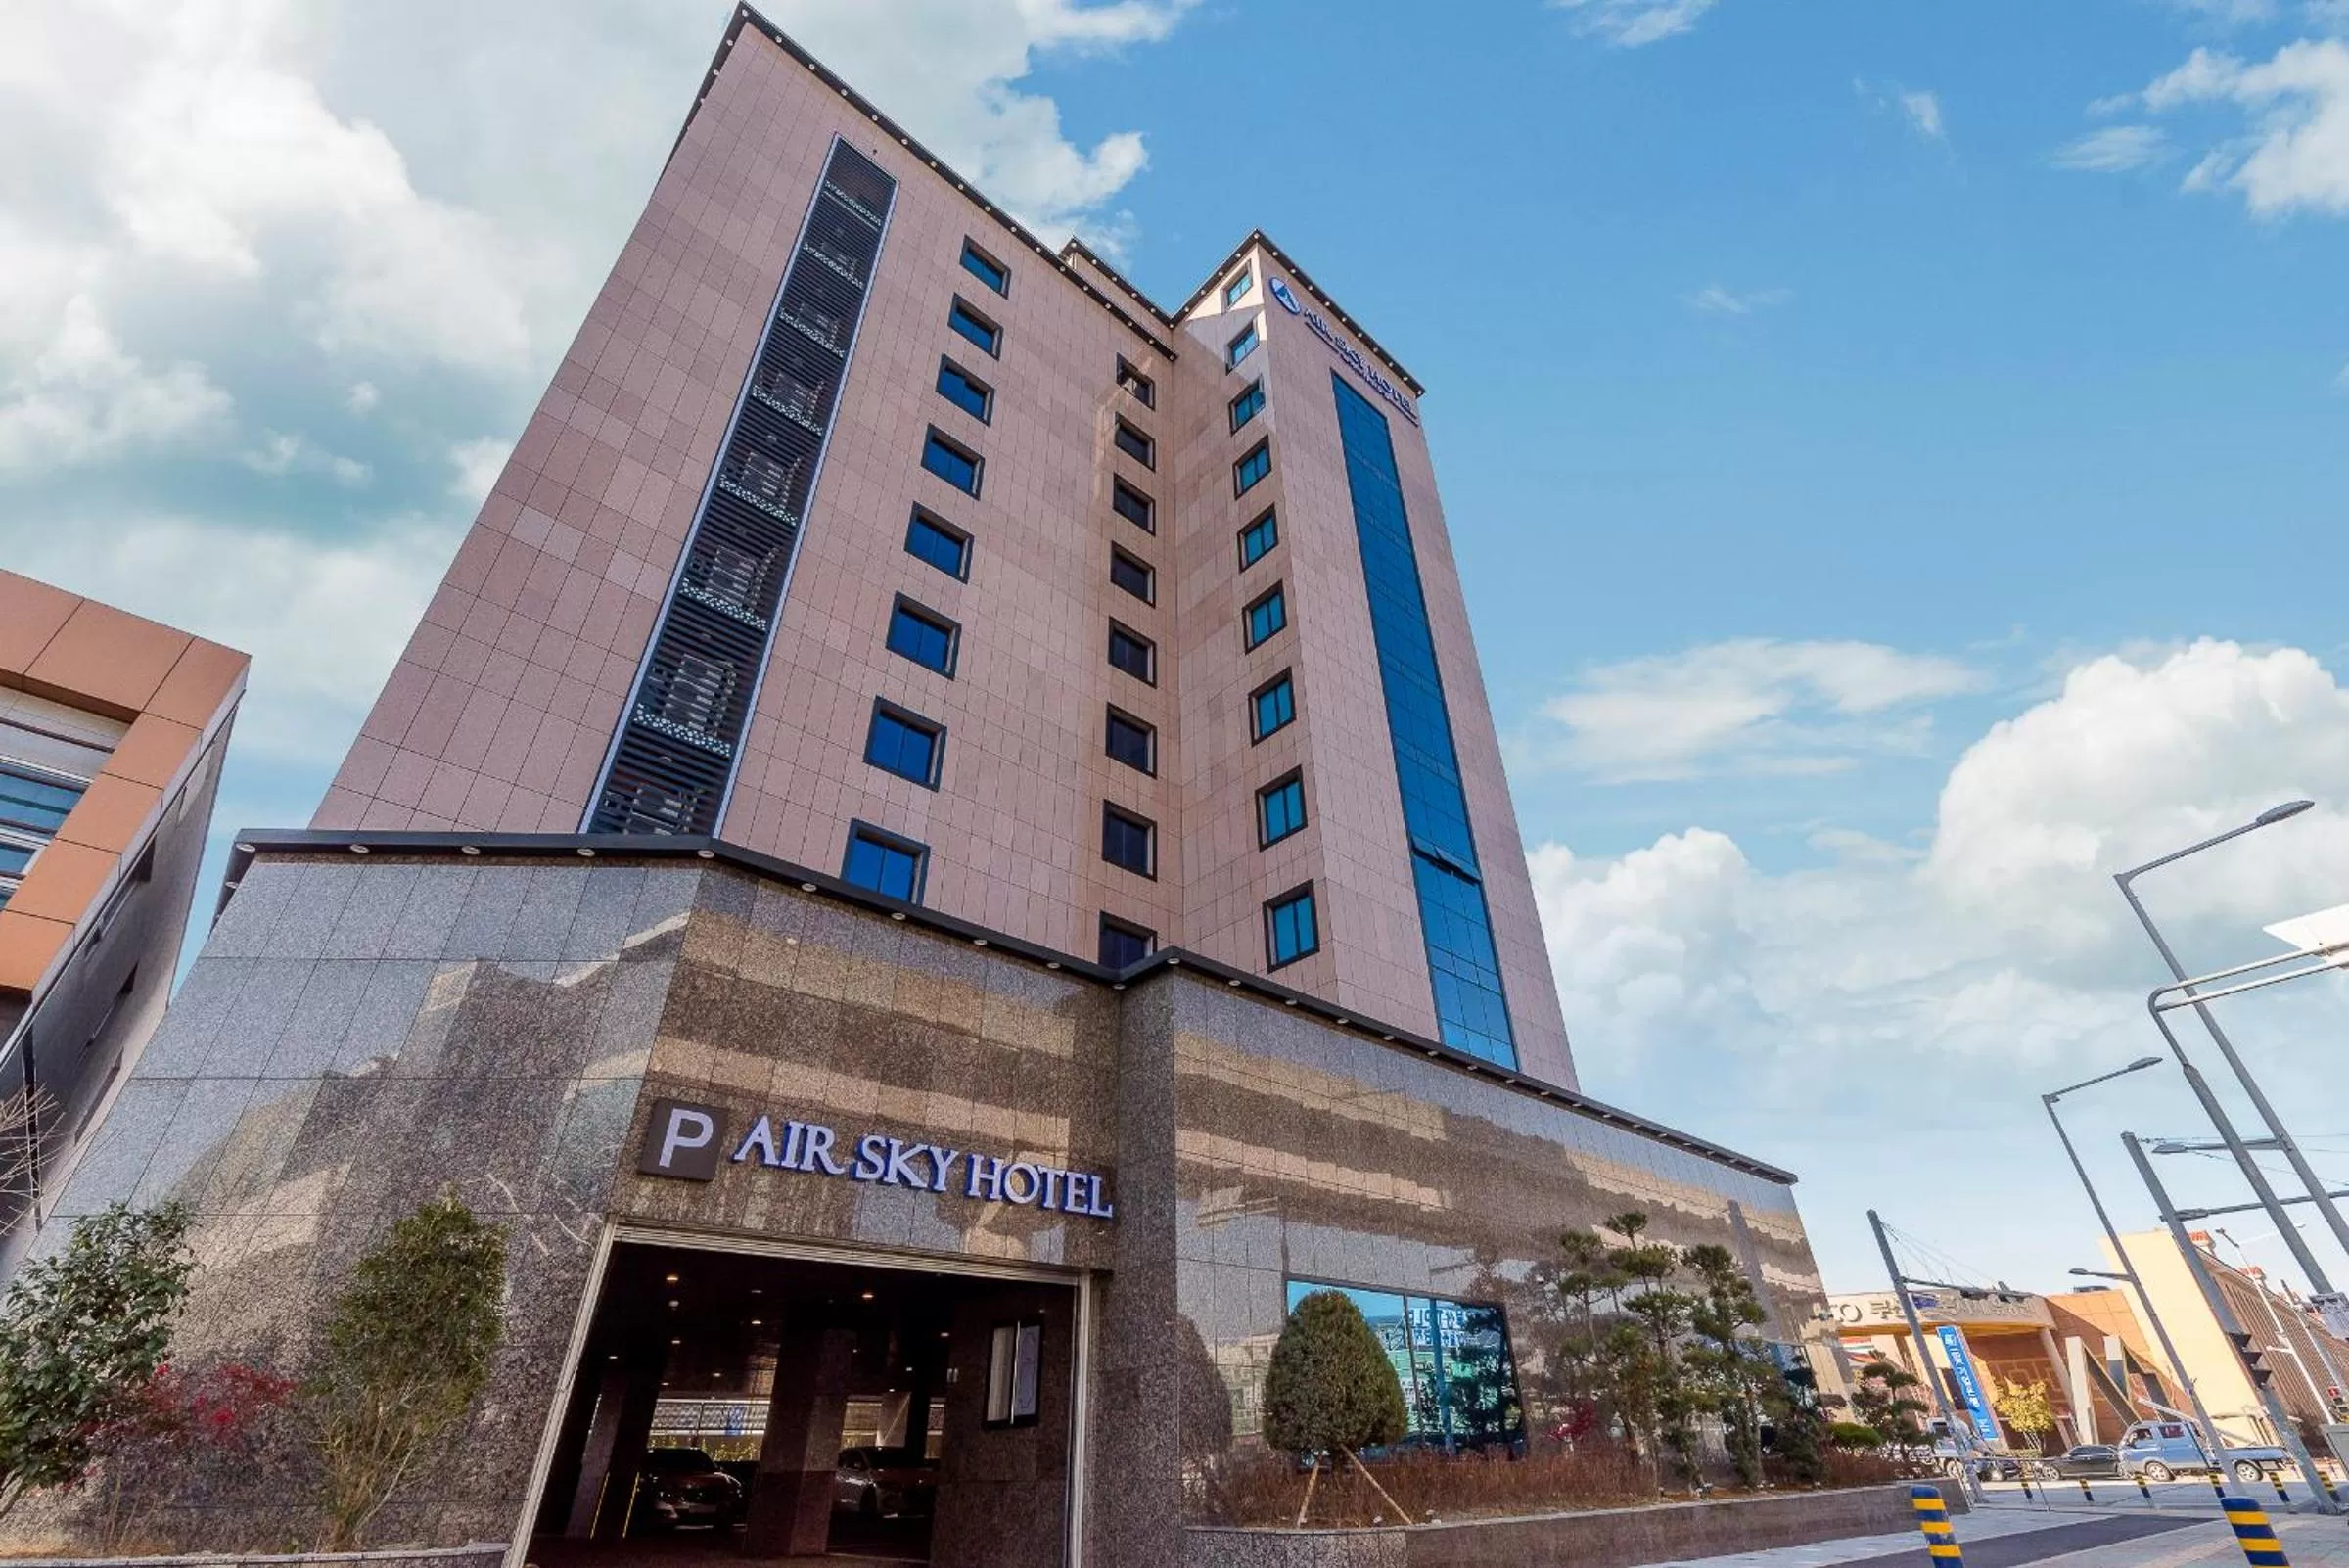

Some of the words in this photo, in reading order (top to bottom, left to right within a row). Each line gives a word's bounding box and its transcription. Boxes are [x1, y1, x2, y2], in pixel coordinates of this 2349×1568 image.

[659, 1107, 714, 1169] P
[731, 1114, 846, 1176] AIR
[852, 1133, 959, 1193] SKY
[965, 1153, 1114, 1219] HOTEL
